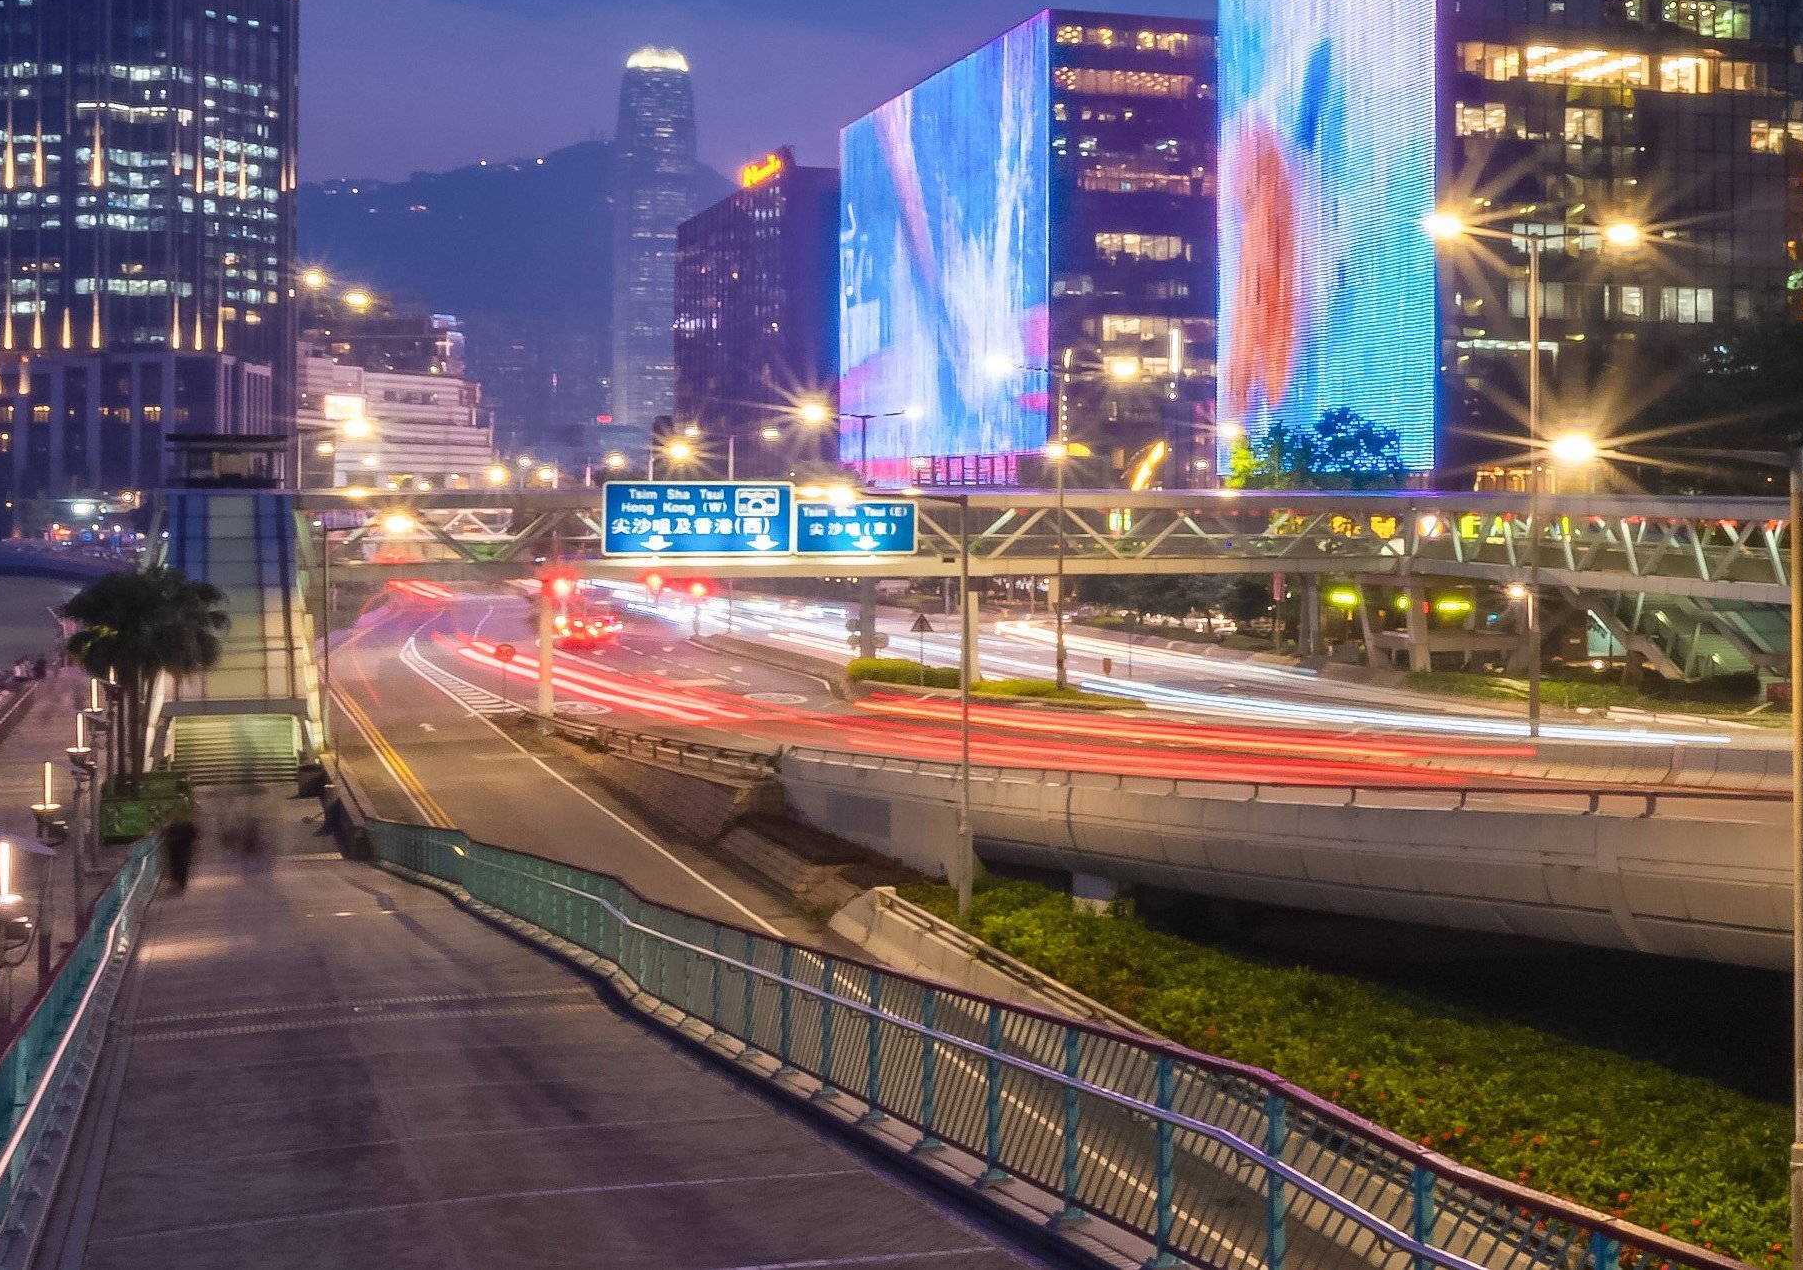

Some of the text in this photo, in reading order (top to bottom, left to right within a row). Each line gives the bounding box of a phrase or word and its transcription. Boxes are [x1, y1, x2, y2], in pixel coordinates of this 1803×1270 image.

[629, 488, 725, 501] Tsim Sha Tsui
[621, 501, 728, 516] Hong Kong (W)
[802, 506, 829, 518] Tsim
[863, 506, 887, 518] Tsui
